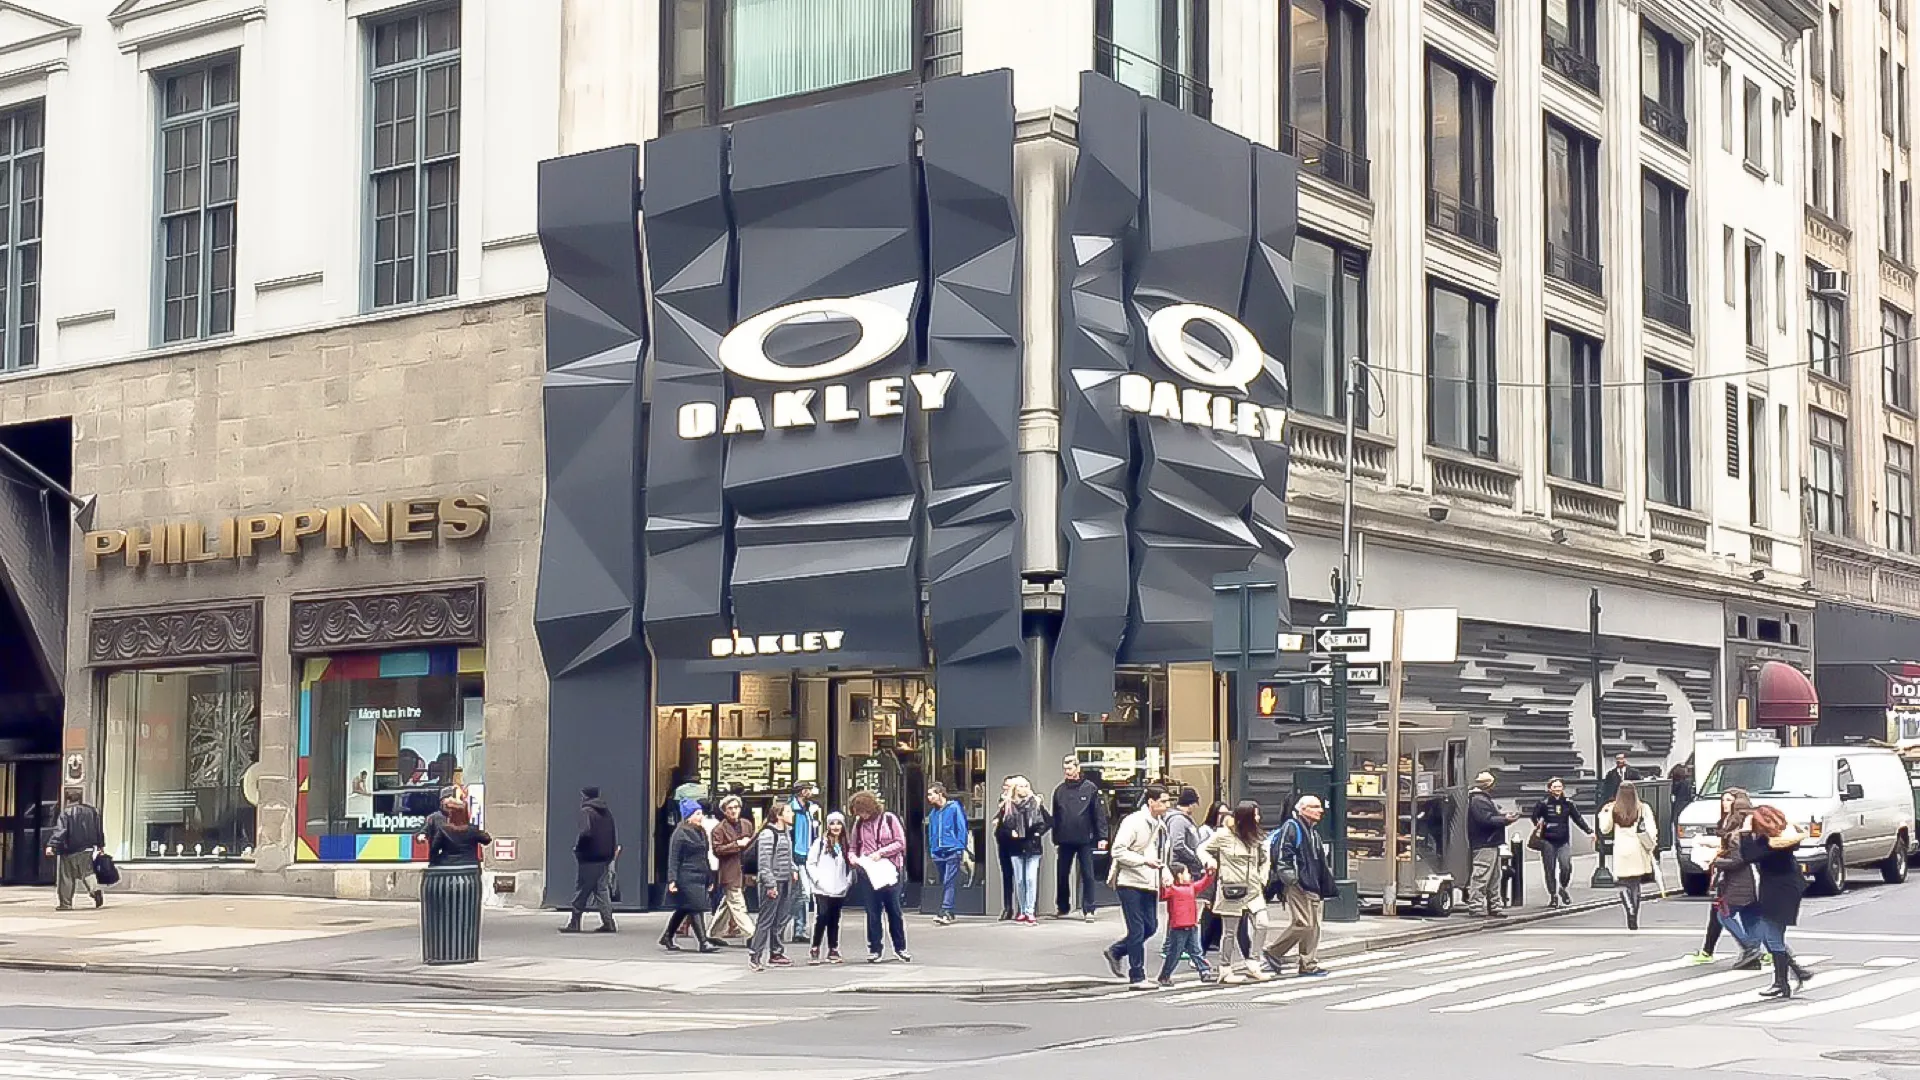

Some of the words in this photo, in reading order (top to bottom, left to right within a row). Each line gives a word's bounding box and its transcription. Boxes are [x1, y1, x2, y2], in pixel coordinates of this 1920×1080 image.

[678, 369, 956, 440] OAKLEY
[1119, 373, 1286, 442] OAKLEY
[84, 495, 490, 570] PHILIPPINES
[711, 630, 844, 656] OAKLEY
[1346, 635, 1363, 645] WAY
[1350, 669, 1373, 680] WAY
[359, 812, 425, 832] Philippines
